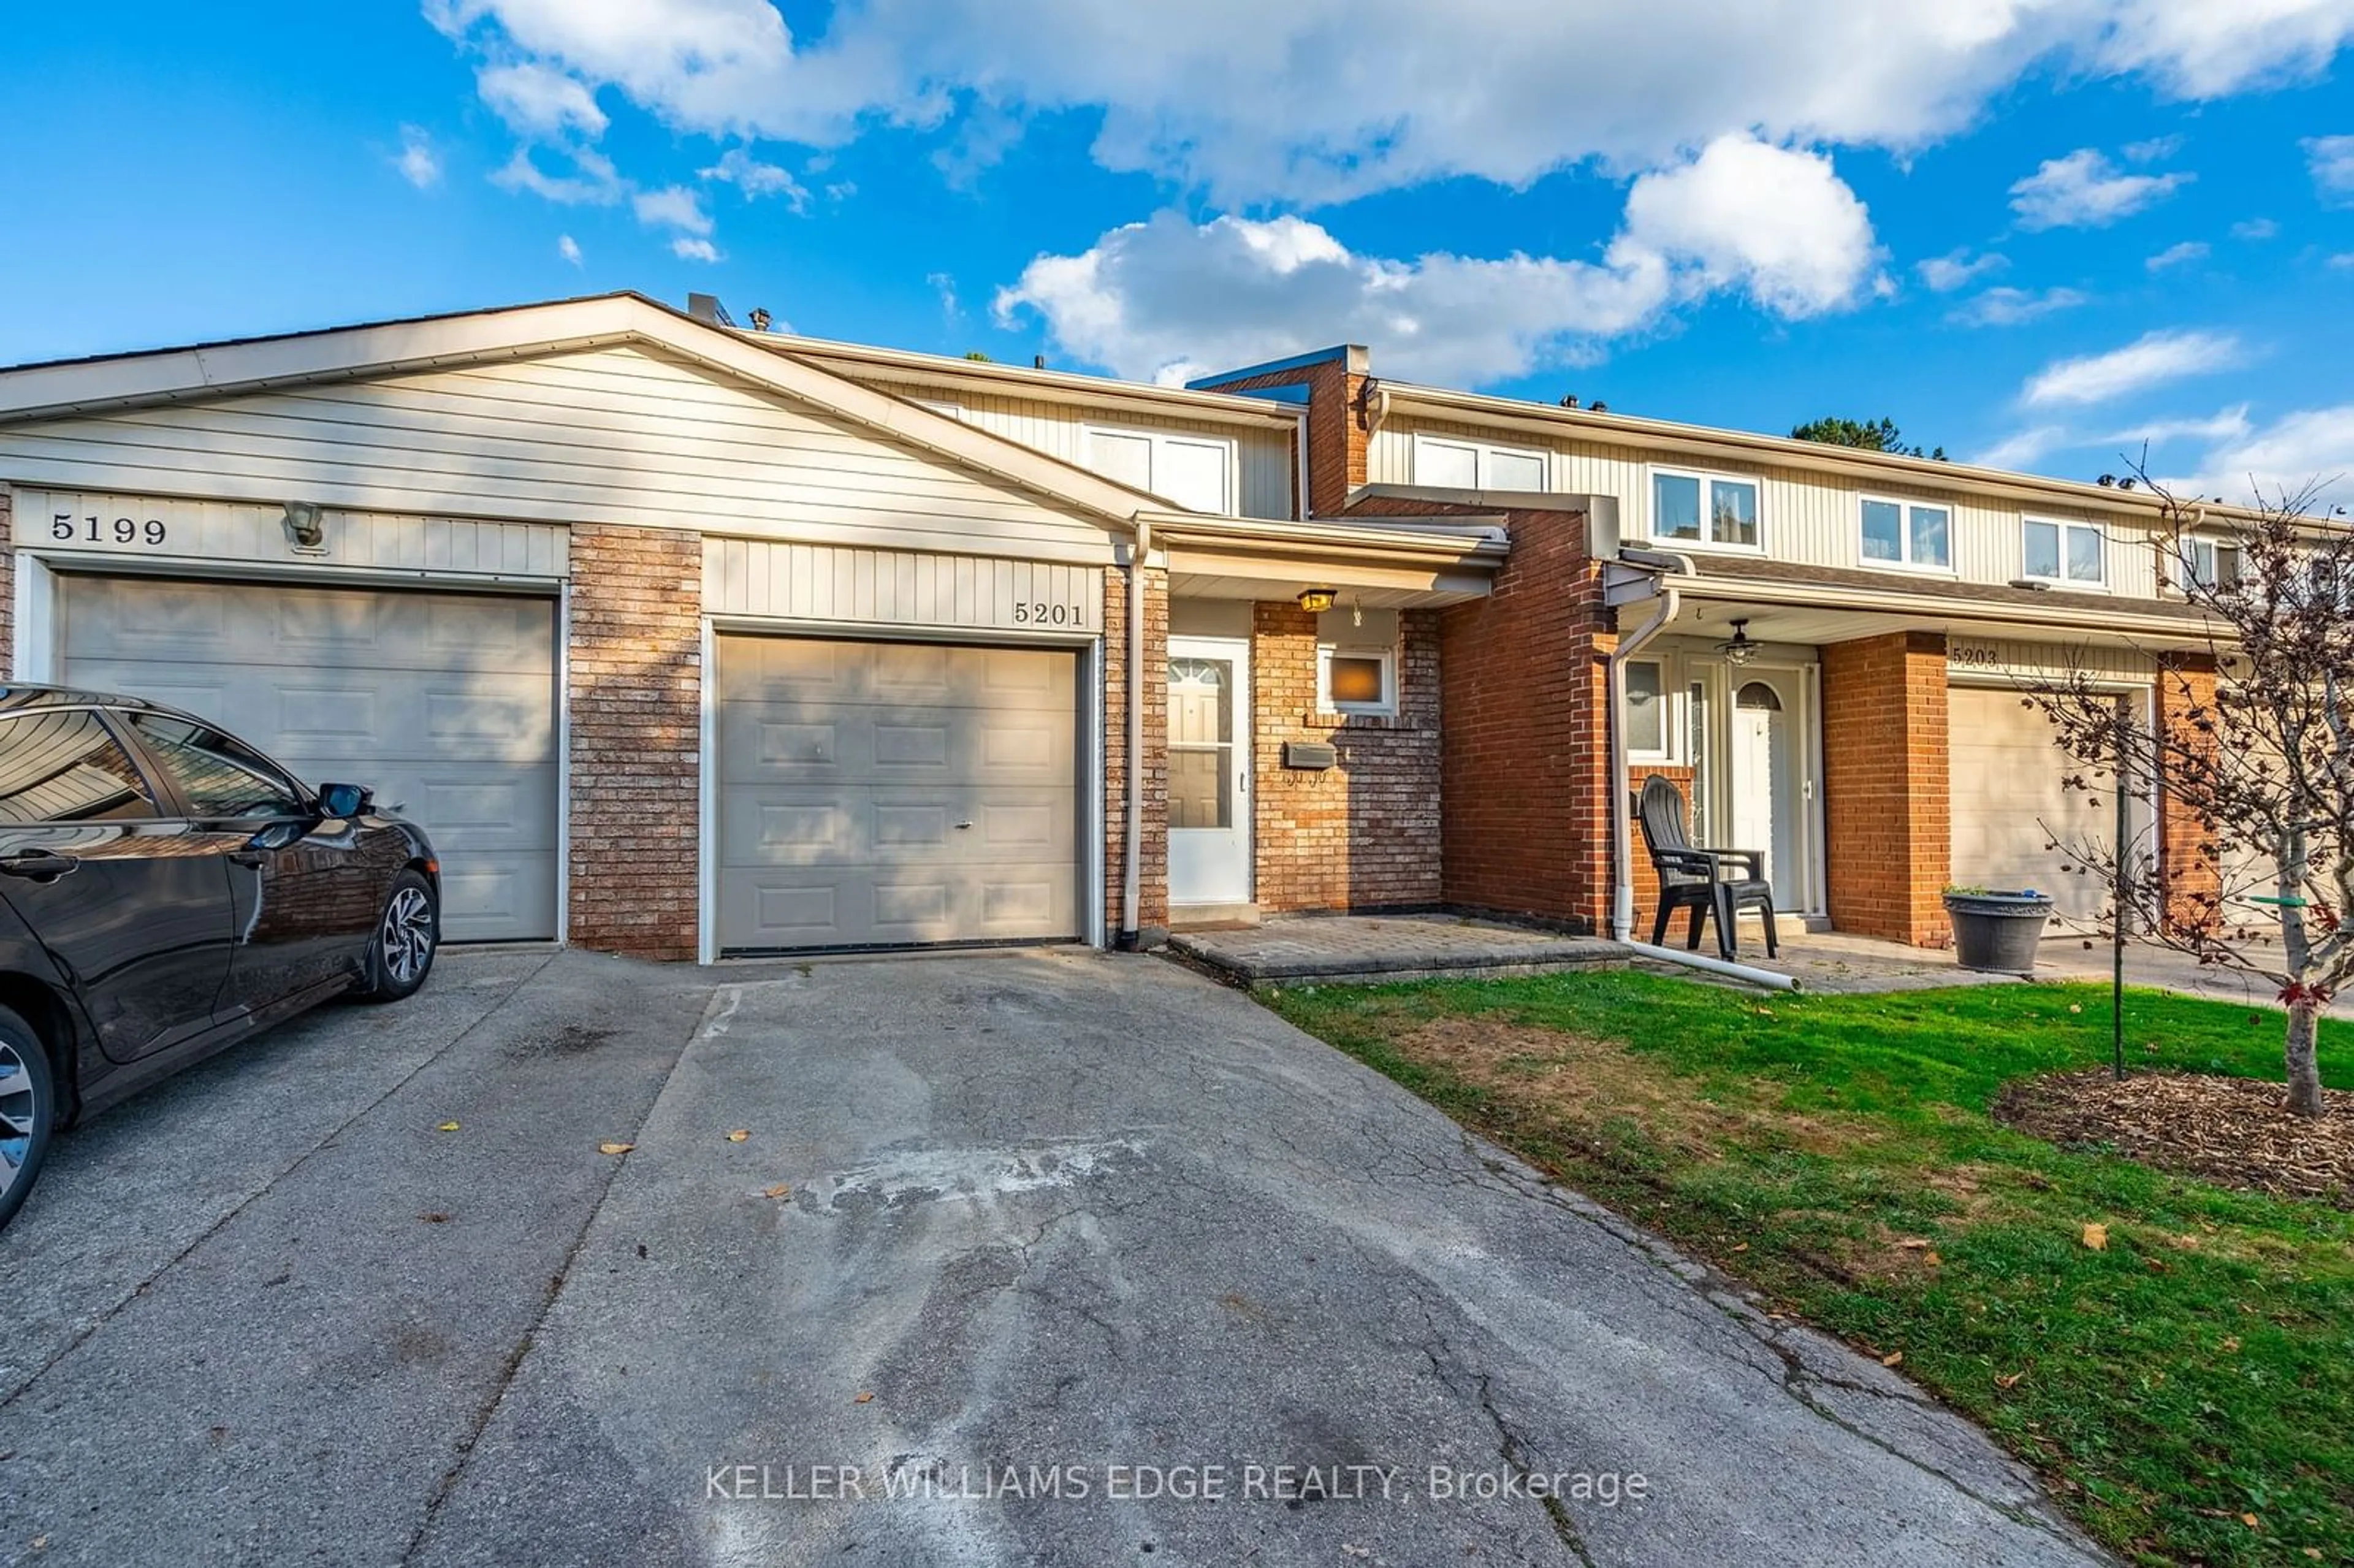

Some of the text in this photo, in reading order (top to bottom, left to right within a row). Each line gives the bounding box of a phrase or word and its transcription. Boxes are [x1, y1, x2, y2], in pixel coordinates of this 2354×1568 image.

[52, 514, 166, 545] 5199
[1015, 602, 1083, 625] 5201
[1953, 647, 1997, 668] 5203
